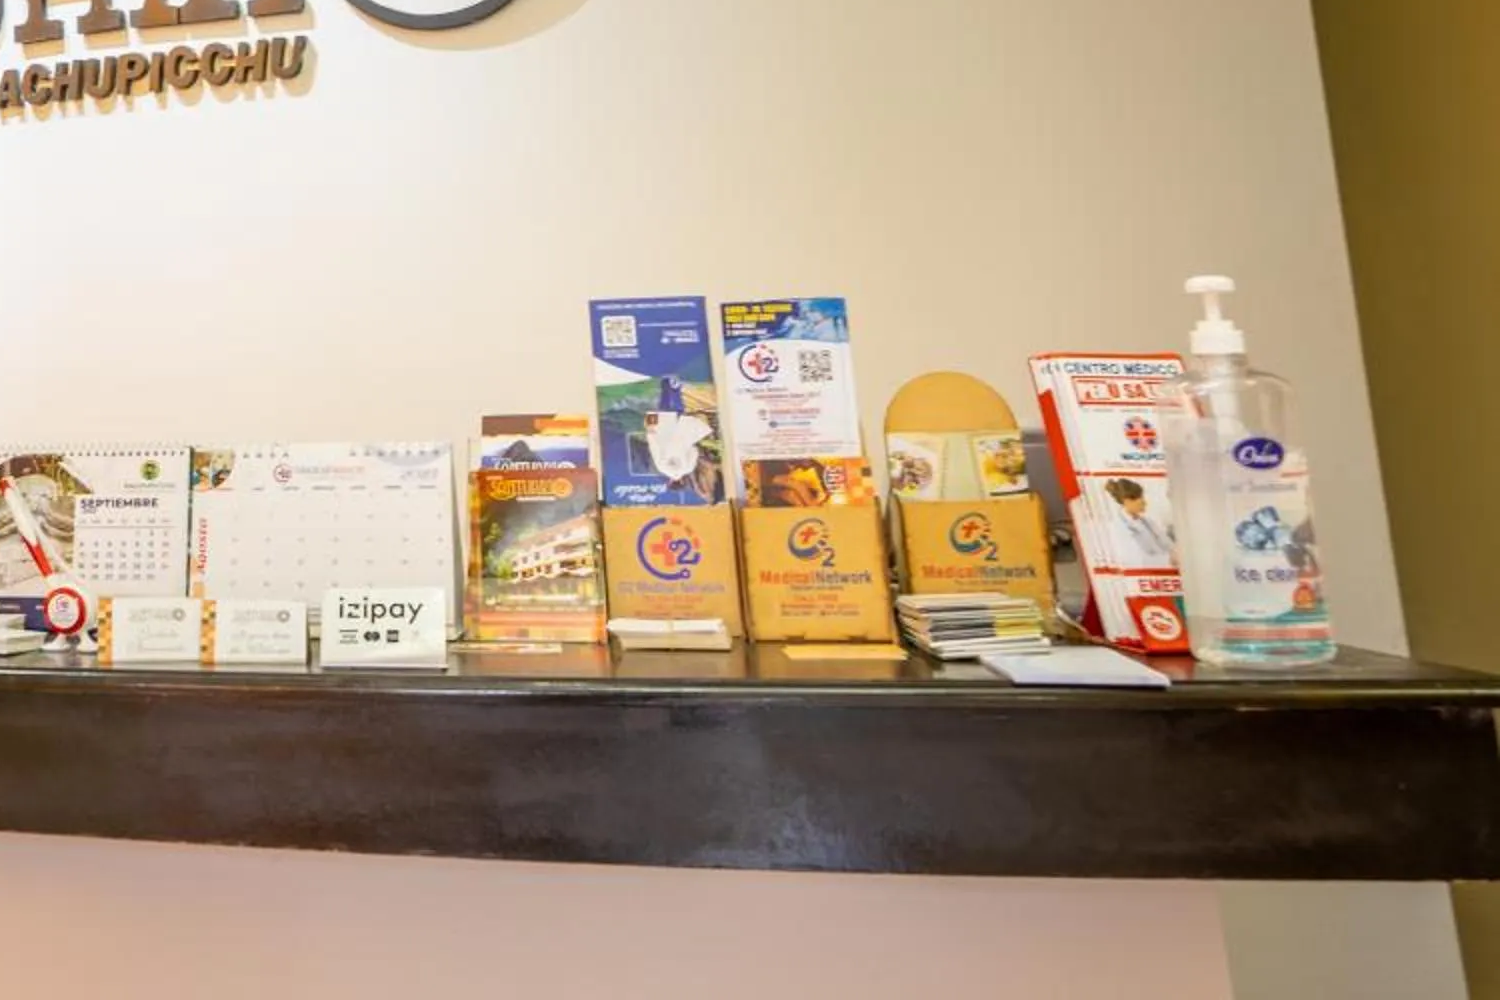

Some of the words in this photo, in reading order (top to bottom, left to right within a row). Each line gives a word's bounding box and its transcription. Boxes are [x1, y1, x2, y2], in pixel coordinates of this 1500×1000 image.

[1064, 363, 1120, 375] CENTRO
[80, 497, 159, 509] SEPTIEMBRE
[339, 596, 424, 624] izipay
